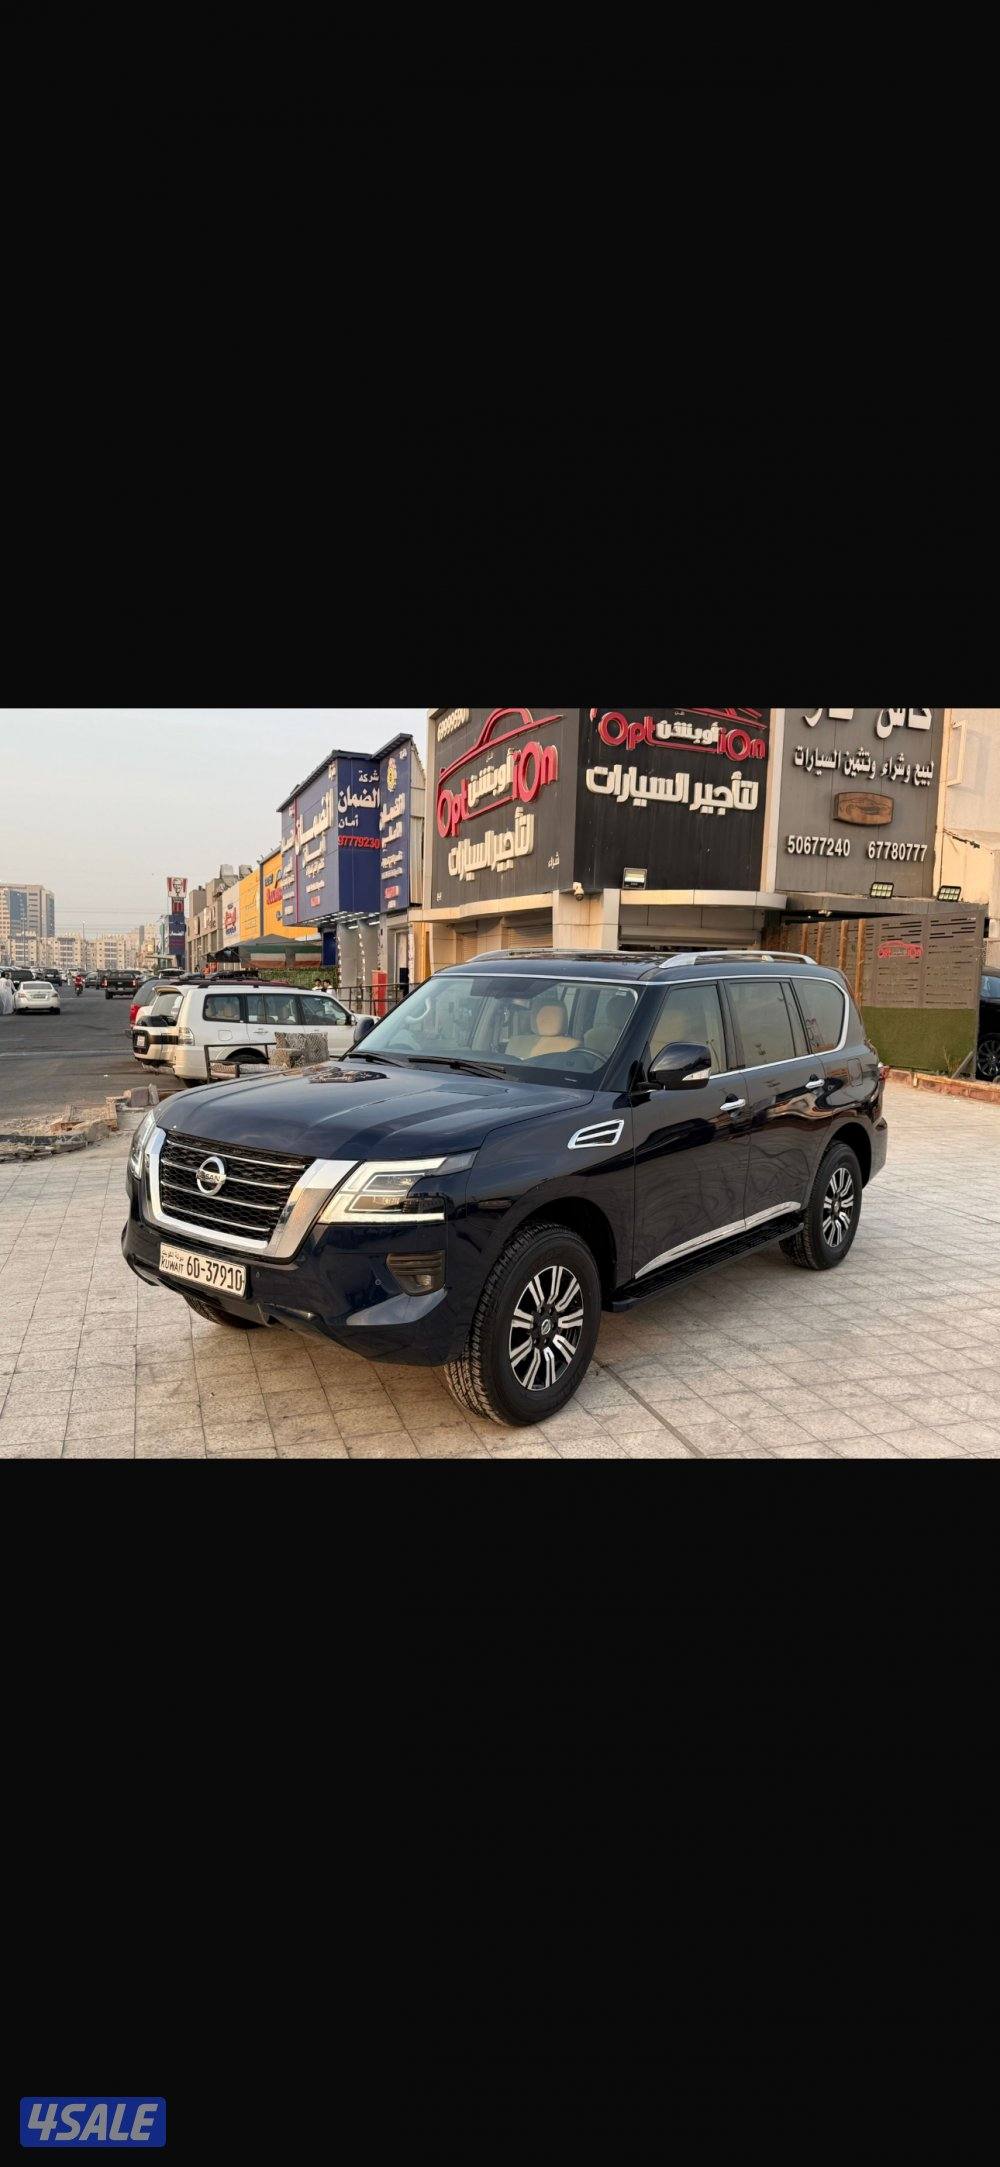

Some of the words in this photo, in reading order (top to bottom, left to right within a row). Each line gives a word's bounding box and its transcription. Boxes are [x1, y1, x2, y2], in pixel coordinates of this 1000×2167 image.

[794, 744, 842, 776] السيارات
[844, 746, 876, 780] وتثمين
[881, 752, 911, 783] وشراء
[913, 760, 935, 785] لبيع
[358, 770, 380, 783] شركة
[586, 764, 690, 807] السيارات
[337, 785, 380, 814] الضمان
[689, 770, 759, 816] لتأجير
[491, 806, 535, 873] لتأجير
[787, 834, 851, 857] 50677240
[868, 841, 928, 862] 67780777
[448, 830, 495, 882] السيارات
[161, 1255, 184, 1273] KUWAIT
[186, 1256, 242, 1291] 60-37910
